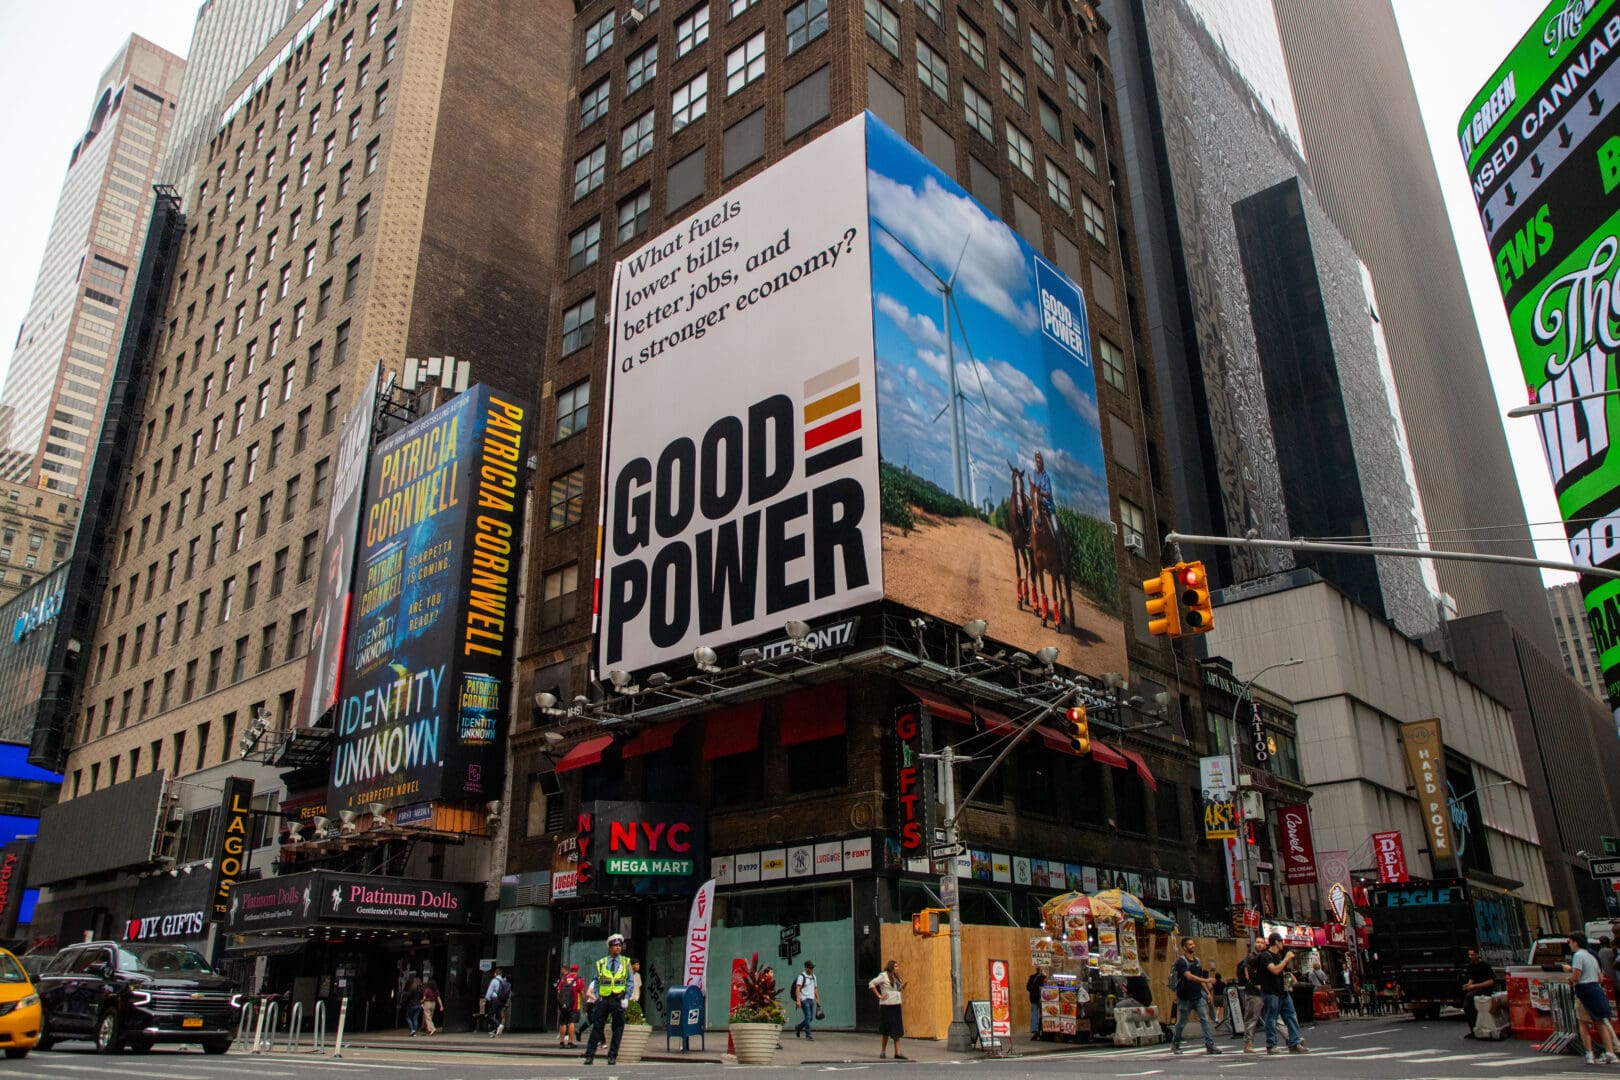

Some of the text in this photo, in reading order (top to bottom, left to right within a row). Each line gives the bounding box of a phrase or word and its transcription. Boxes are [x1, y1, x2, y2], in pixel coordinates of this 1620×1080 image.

[1472, 70, 1517, 145] GREEN
[627, 200, 741, 279] What fuels
[624, 235, 741, 312] lower bills,
[624, 227, 791, 342] better jobs, and
[621, 227, 857, 374] a stronger economy?
[1041, 288, 1073, 328] GOOD
[1043, 308, 1084, 357] POWER
[378, 414, 459, 498] PATRICIA
[612, 393, 795, 557] GOOD
[366, 460, 459, 548] CORNWELL
[464, 396, 524, 657] PATRICIA CORNWELL
[367, 549, 404, 592] PATRICIA
[407, 557, 451, 585] IS COMING.
[408, 539, 453, 569] SCARPETTA
[606, 477, 870, 666] POWER
[360, 572, 402, 617] CORNWELL
[408, 591, 442, 616] ARE YOU
[357, 613, 397, 651] IDENTITY
[408, 609, 439, 632] READY?
[355, 632, 394, 671] UNKNOWN
[339, 664, 446, 737] IDENTITY
[462, 693, 500, 711] CORNWELL
[466, 679, 499, 697] PATRICIA
[460, 727, 496, 739] UNKNOWN
[461, 717, 497, 729] IDENTITY
[1250, 703, 1268, 761] TATTOO
[334, 716, 444, 788] UNKNOWN.
[1418, 749, 1437, 794] HARD
[358, 786, 394, 805] SCARPETTA
[397, 780, 420, 797] NOVEL
[1204, 803, 1236, 827] ART
[218, 793, 248, 897] LAGOS
[577, 812, 592, 884] NYC
[610, 821, 691, 853] NYC
[852, 849, 871, 858] FDNY
[611, 860, 688, 873] MEGA MART
[743, 863, 758, 871] NYPD
[1380, 839, 1400, 883] DEL
[1598, 863, 1616, 873] ONE
[278, 885, 300, 905] Dolls
[348, 885, 458, 909] Platinum Dolls
[356, 906, 393, 915] Gentlemen's
[394, 908, 408, 916] Club
[409, 909, 419, 917] and
[420, 910, 438, 919] Sports
[138, 917, 158, 938] NY
[161, 911, 204, 937] GIFTS
[584, 912, 602, 926] ATM
